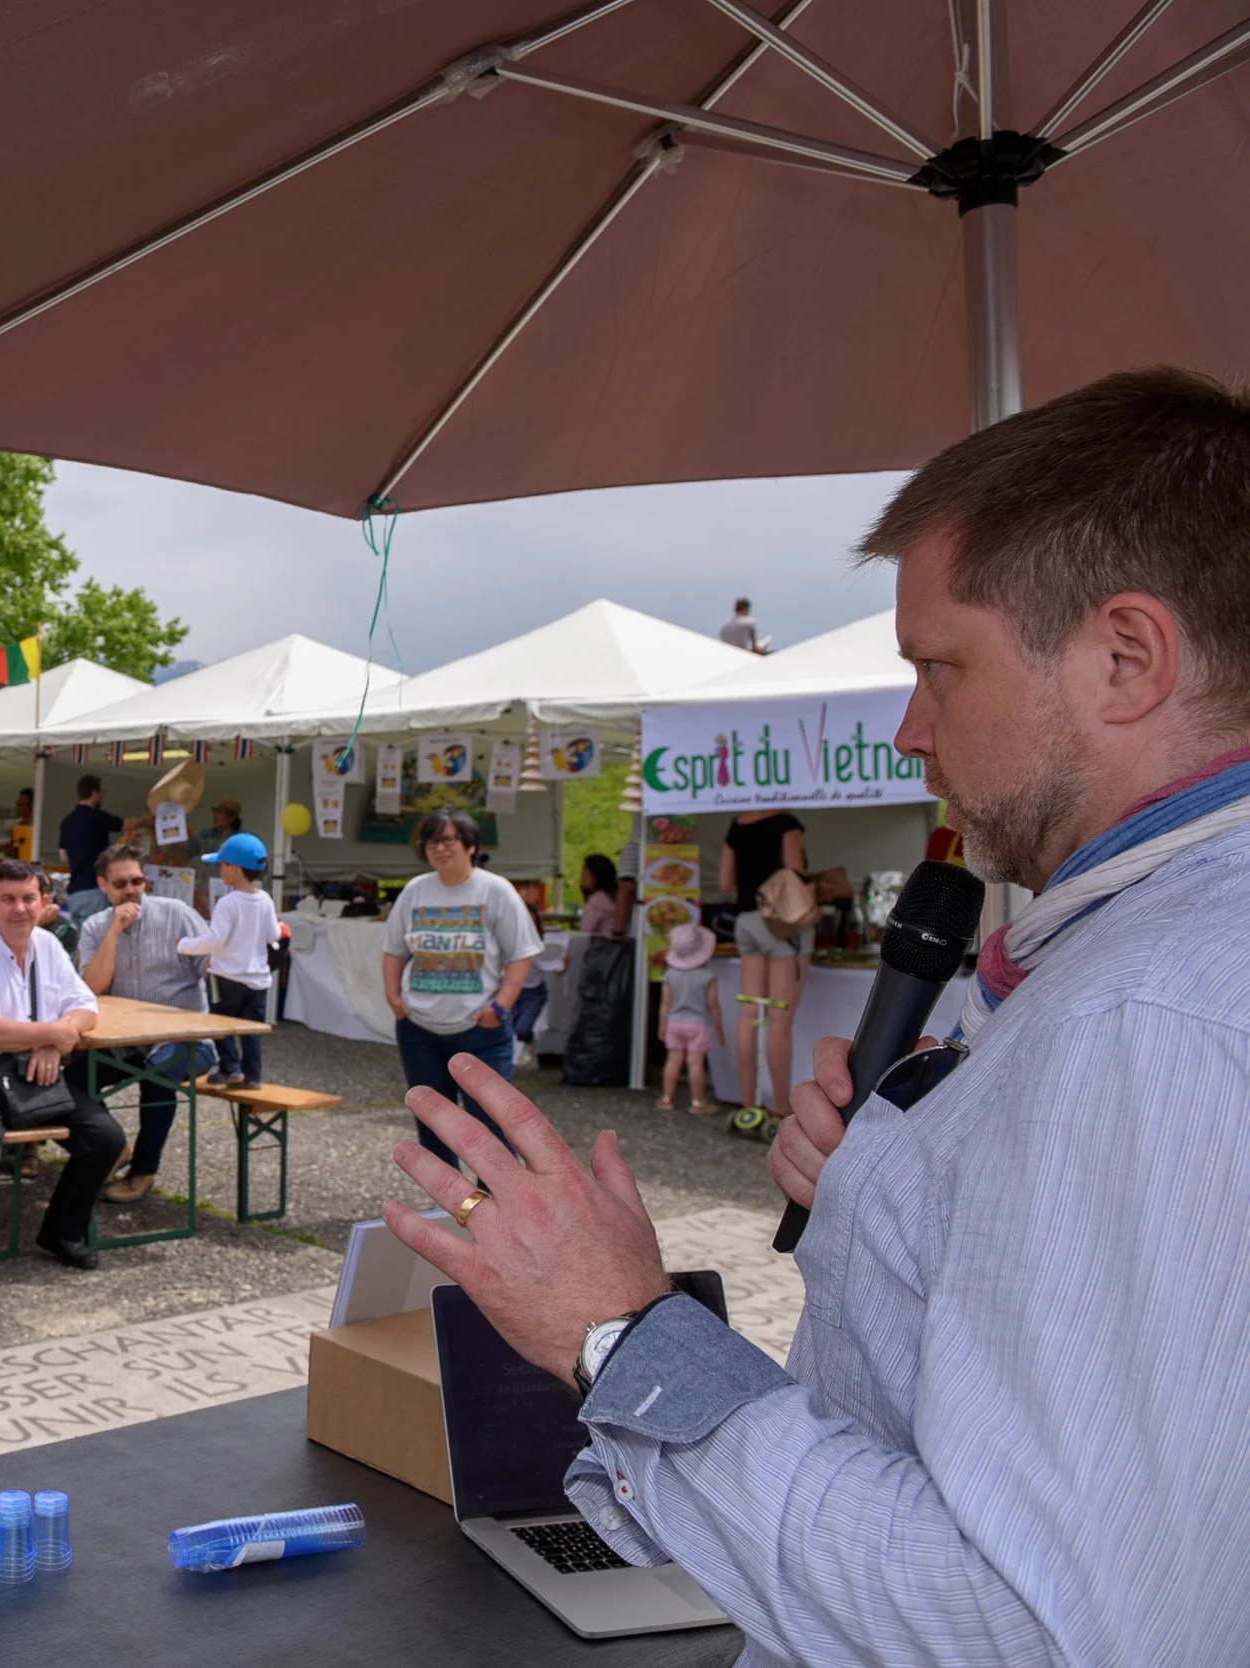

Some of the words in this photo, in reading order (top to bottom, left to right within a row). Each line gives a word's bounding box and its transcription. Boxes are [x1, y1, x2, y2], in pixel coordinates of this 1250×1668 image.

[642, 729, 746, 799] Esprit
[754, 724, 791, 786] du
[798, 701, 924, 784] Vietna
[122, 1341, 250, 1380] SÜN
[163, 1372, 248, 1402] ILS
